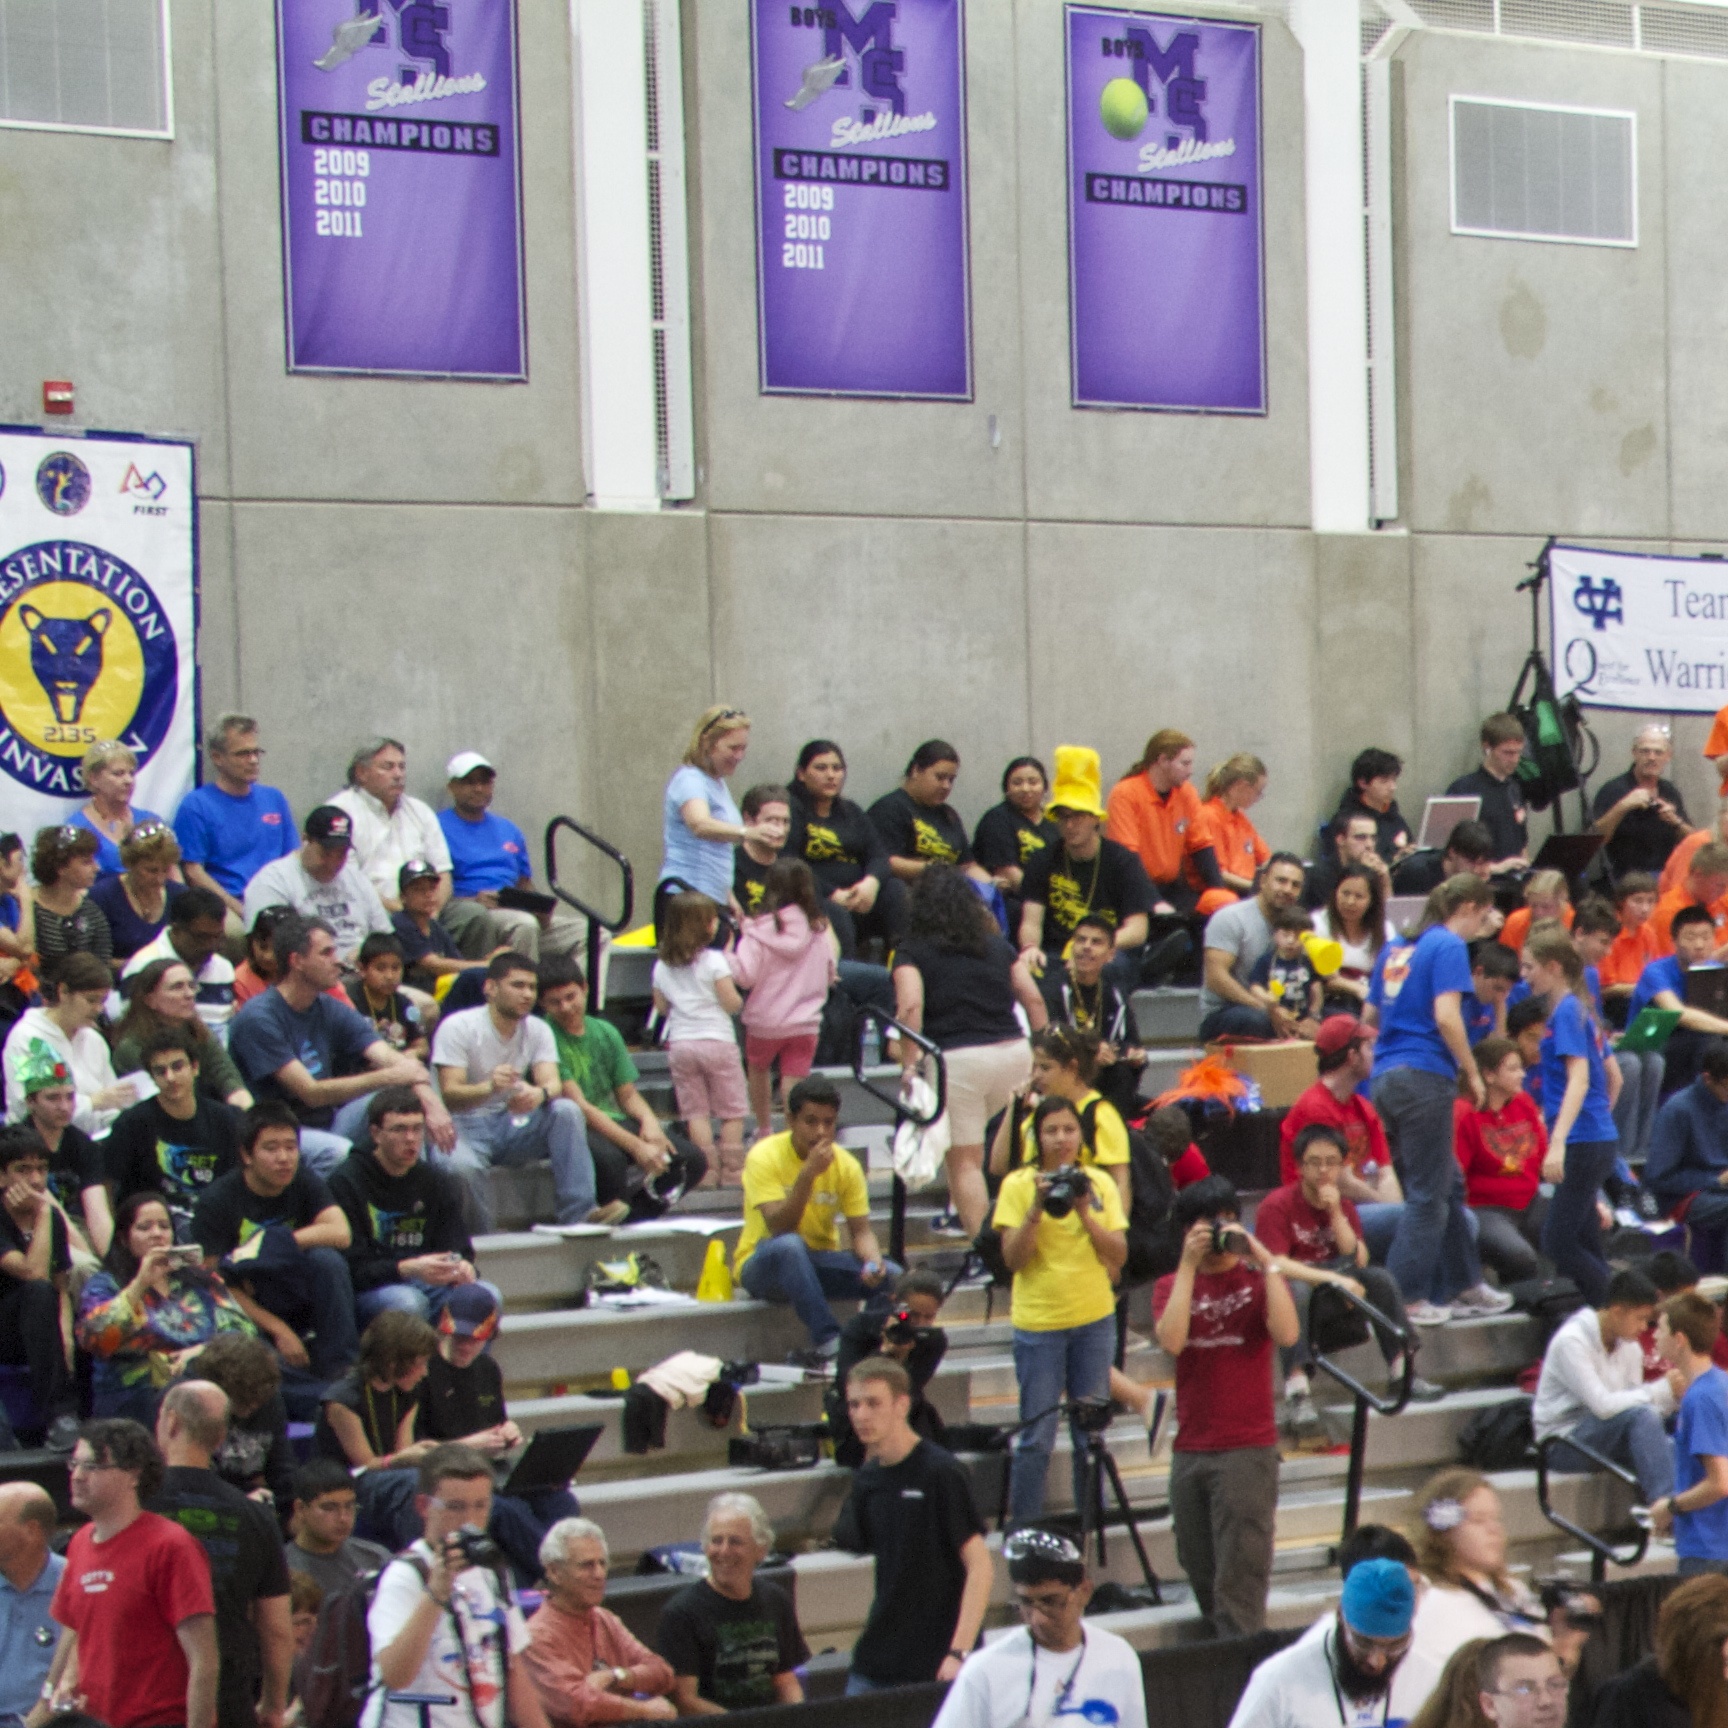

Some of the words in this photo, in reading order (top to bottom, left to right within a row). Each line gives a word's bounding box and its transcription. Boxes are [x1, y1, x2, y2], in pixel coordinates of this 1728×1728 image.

[309, 116, 494, 152] CHAMPIONS
[313, 149, 370, 178] 2009
[782, 154, 944, 187] CHAMPIONS
[314, 179, 366, 208] 2010
[783, 183, 834, 211] 2009
[1092, 178, 1243, 211] CHAMPIONS
[316, 209, 363, 238] 2011
[784, 213, 831, 241] 2010
[782, 243, 825, 270] 2011
[133, 504, 168, 517] FIRST
[44, 726, 96, 743] 2135
